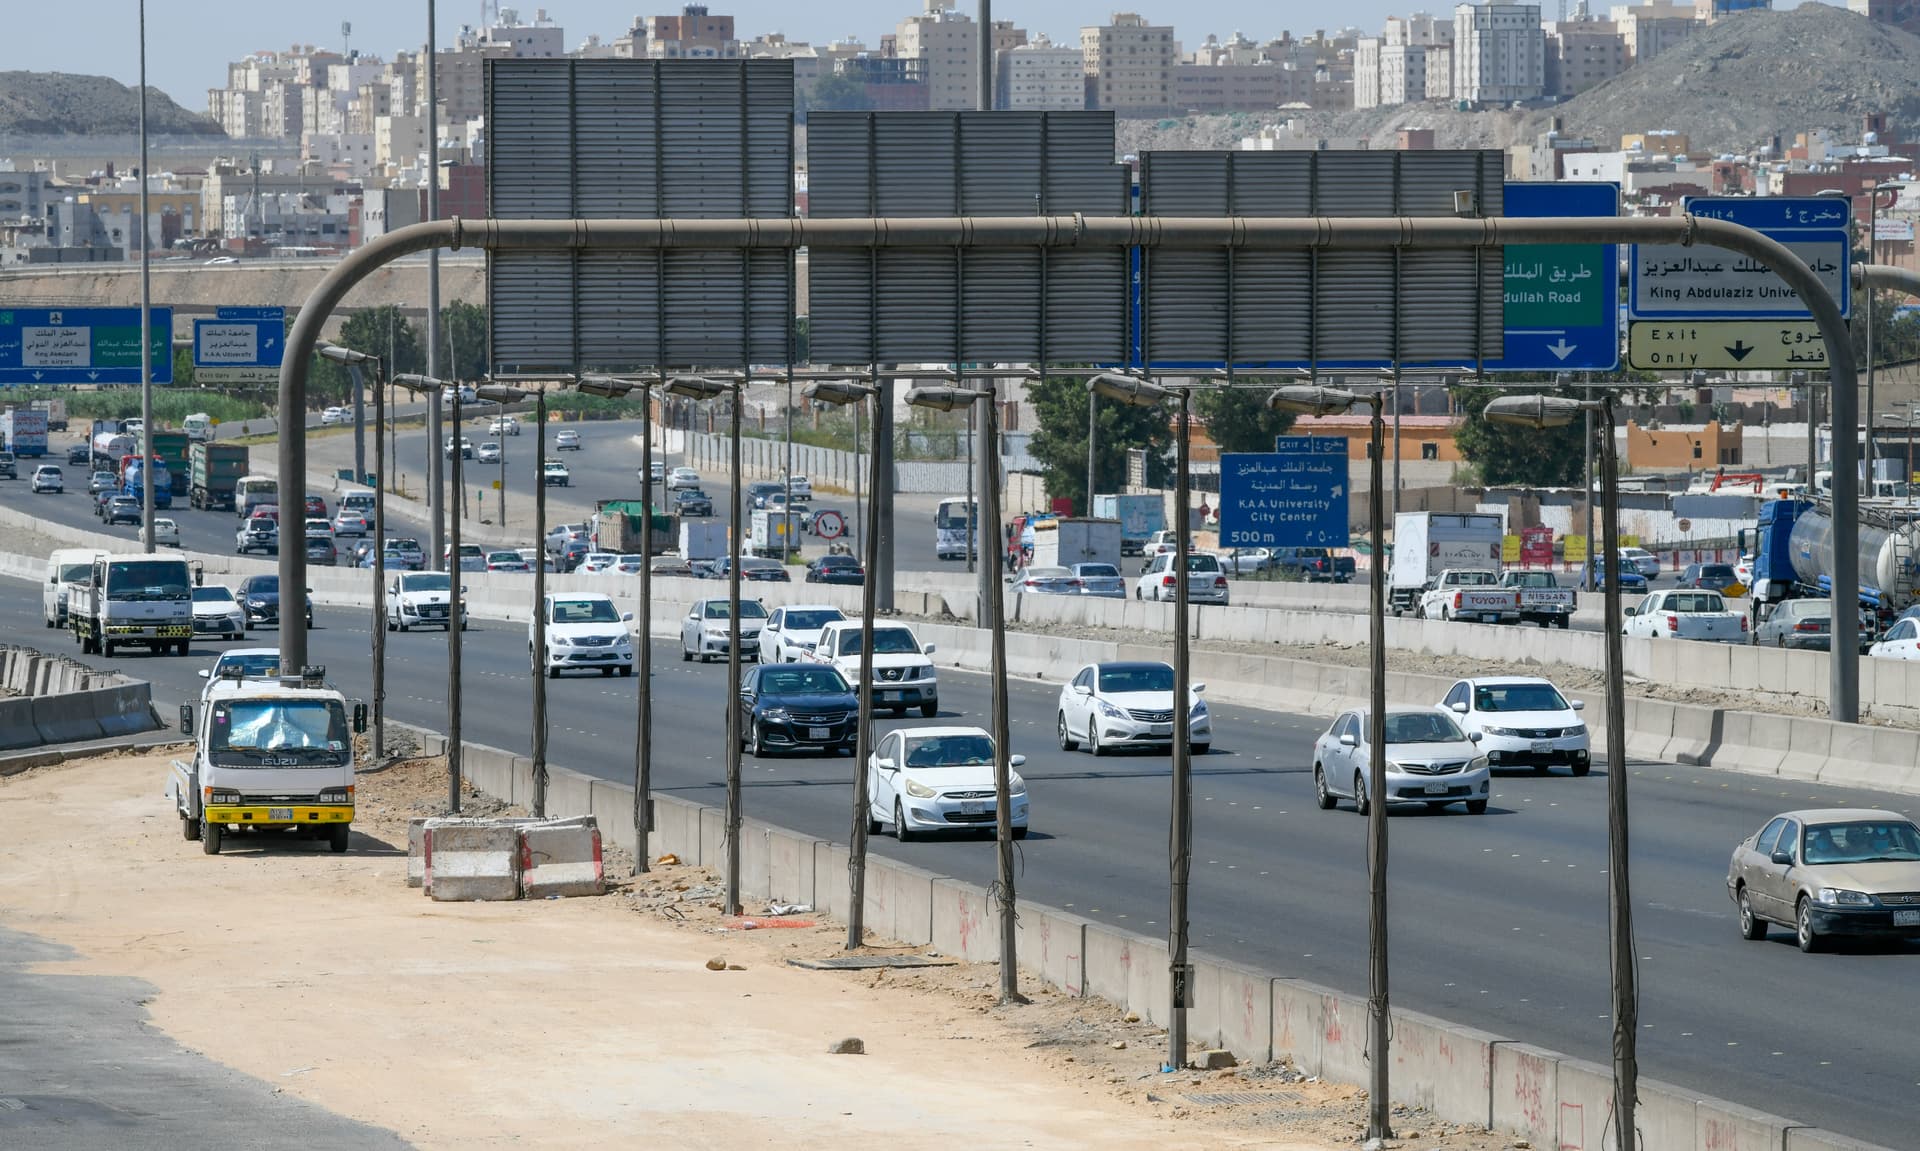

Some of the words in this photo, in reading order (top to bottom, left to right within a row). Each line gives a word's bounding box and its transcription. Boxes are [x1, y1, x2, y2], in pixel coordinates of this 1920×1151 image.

[1726, 210, 1734, 220] 4
[1785, 207, 1793, 219] ٤
[1799, 208, 1841, 223] مخرج
[1549, 263, 1592, 283] طريق
[1642, 257, 1724, 276] عبدالعزيز
[1732, 259, 1772, 274] ملك
[1810, 258, 1837, 275] جام
[1504, 291, 1544, 303] dullah
[1548, 291, 1581, 303] Road
[1650, 287, 1680, 300] King
[1687, 286, 1753, 298] Abdulaziz
[1759, 287, 1798, 298] Unive
[1652, 330, 1697, 340] Exit
[1651, 352, 1698, 365] Only
[1786, 348, 1825, 362] فقط
[1237, 461, 1277, 476] عبدالعزيز
[1280, 461, 1304, 473] الملك
[1307, 461, 1333, 474] جامعة
[1251, 479, 1285, 492] المدينة
[1289, 478, 1318, 493] وسط
[1270, 499, 1330, 510] University
[1250, 512, 1275, 523] City
[1280, 512, 1318, 521] Center
[1231, 531, 1260, 543] 500
[1263, 533, 1275, 543] m
[1470, 596, 1507, 605] TOYOTA
[1528, 593, 1568, 601] NISSAN
[261, 757, 298, 766] ISUZU
